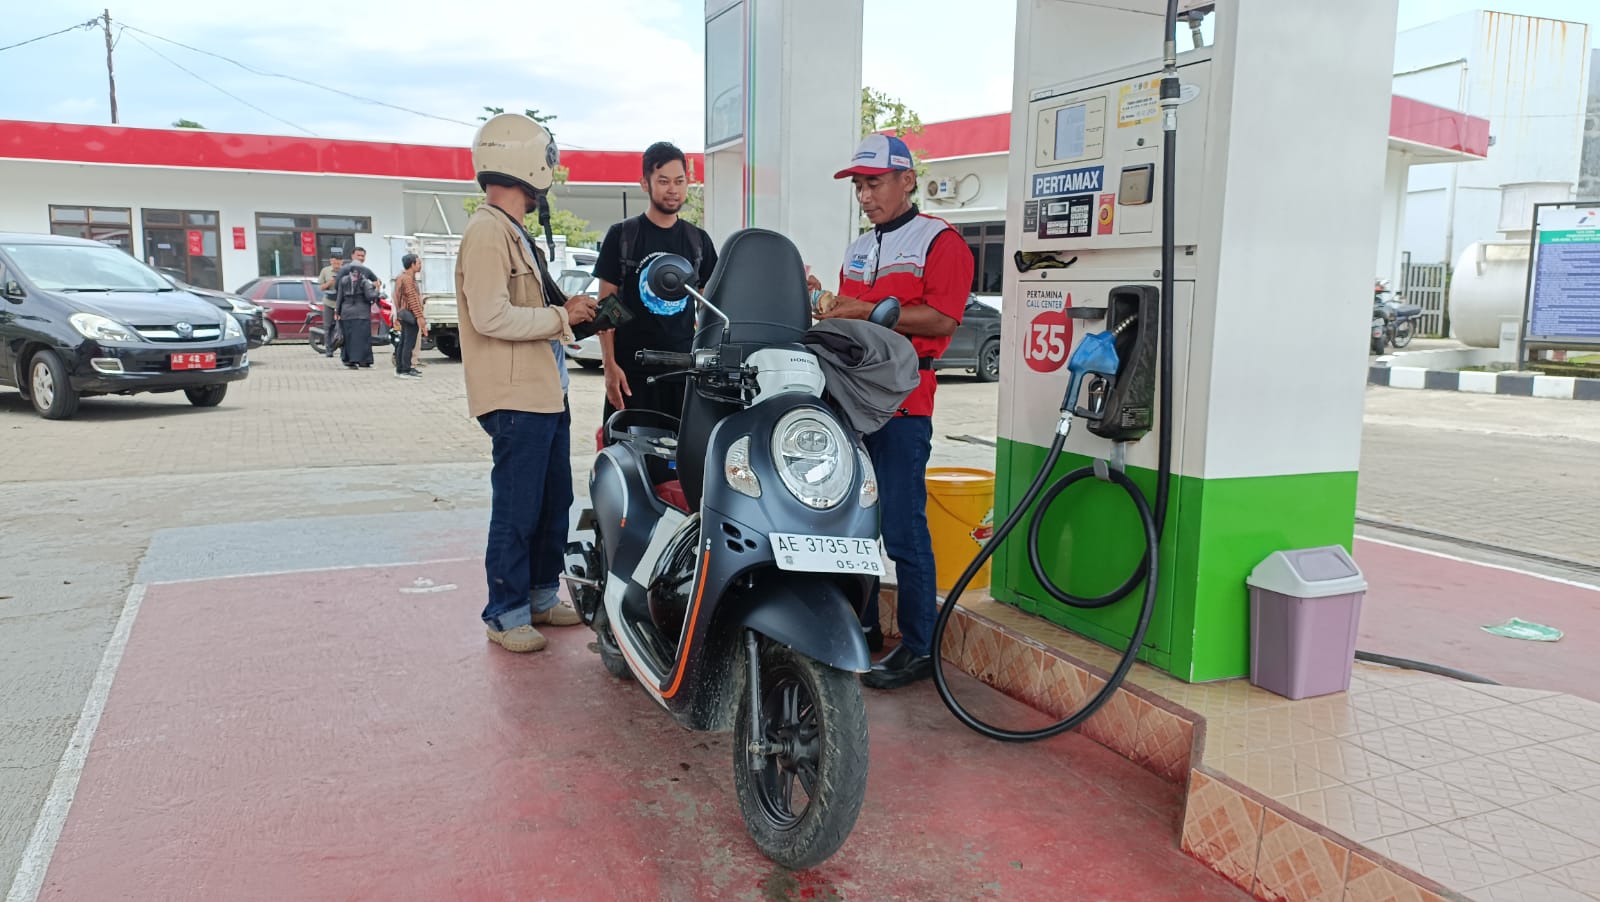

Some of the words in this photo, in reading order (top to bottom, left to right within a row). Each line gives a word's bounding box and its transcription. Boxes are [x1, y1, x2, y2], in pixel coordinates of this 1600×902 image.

[1035, 170, 1100, 195] PERTAMAX
[1026, 290, 1063, 299] PERTAMINA
[1026, 299, 1040, 308] CALL
[1041, 300, 1063, 309] CENTER
[1025, 323, 1066, 363] 135
[778, 536, 800, 552] AE
[805, 537, 849, 554] 3735
[852, 539, 873, 555] ZF
